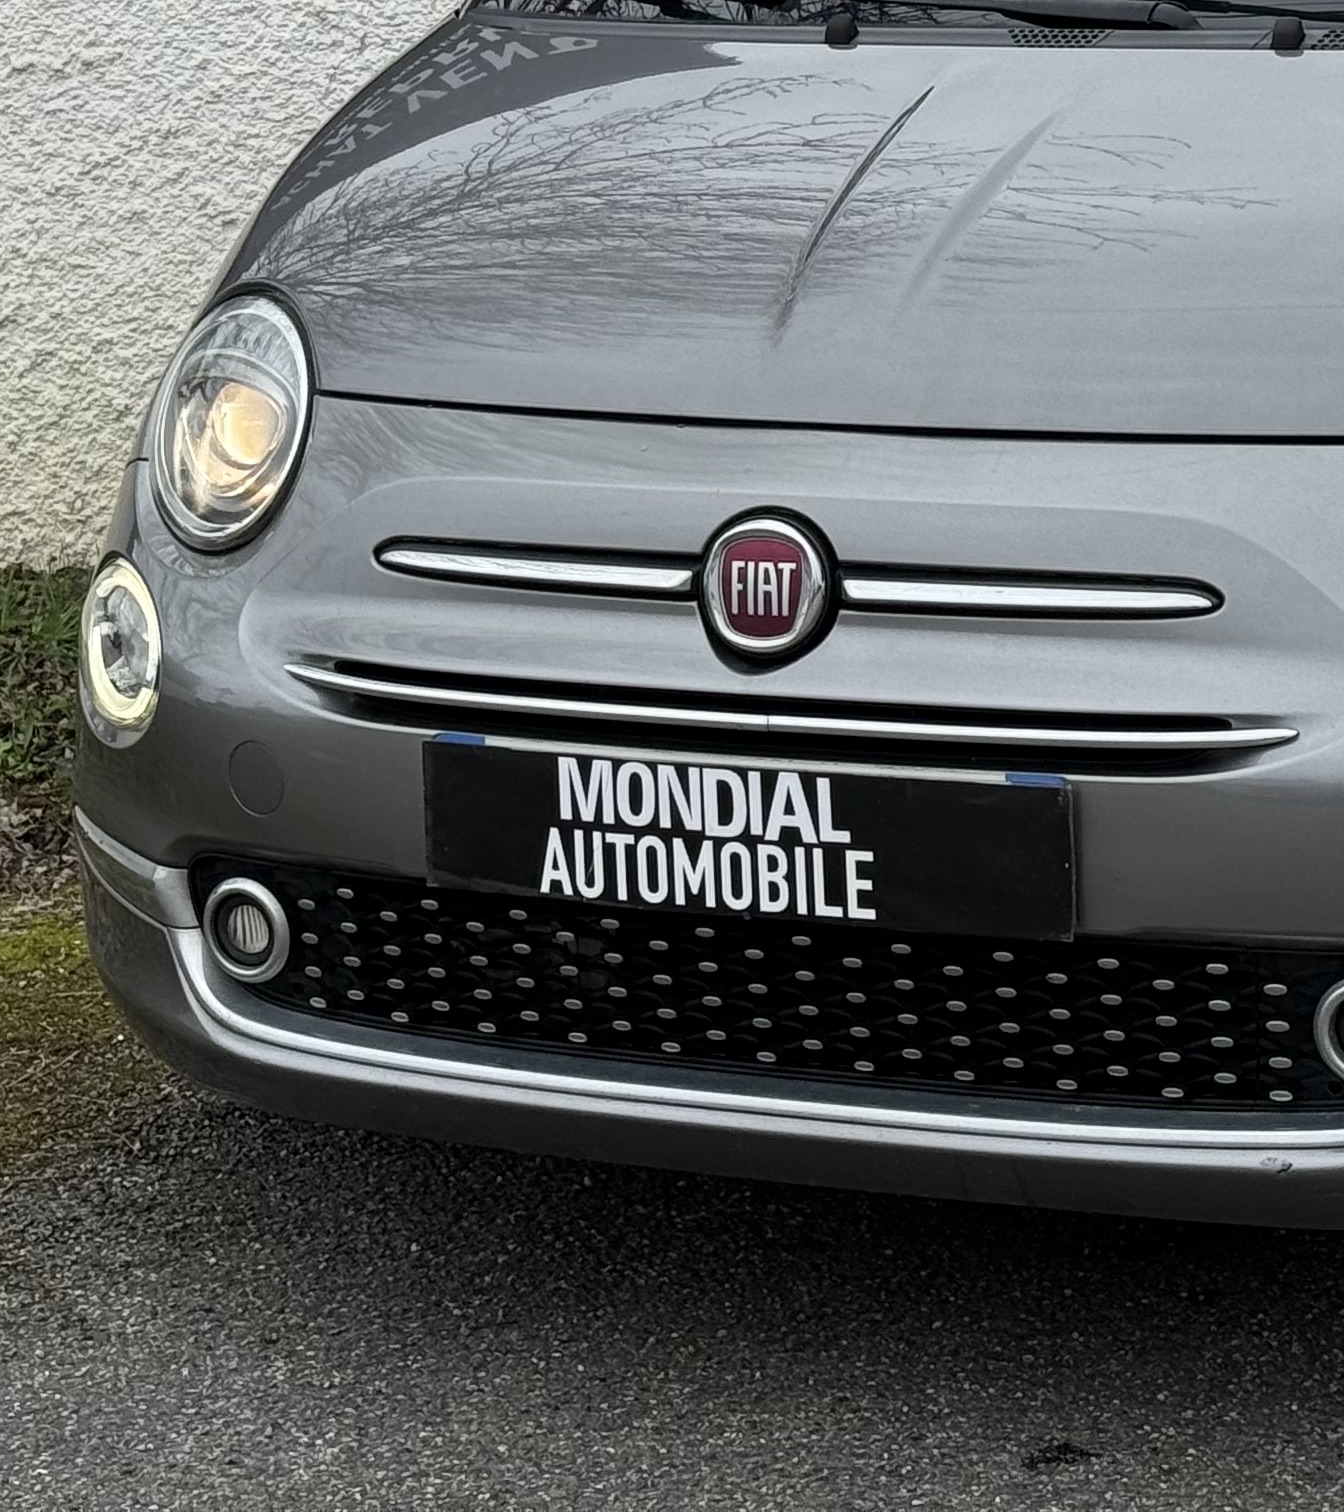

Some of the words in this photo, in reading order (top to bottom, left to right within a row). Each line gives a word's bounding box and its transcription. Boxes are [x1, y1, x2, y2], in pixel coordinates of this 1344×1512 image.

[731, 560, 798, 617] FIAT
[557, 755, 852, 845] MONDIAL
[539, 825, 878, 921] AUTOMOBILE
